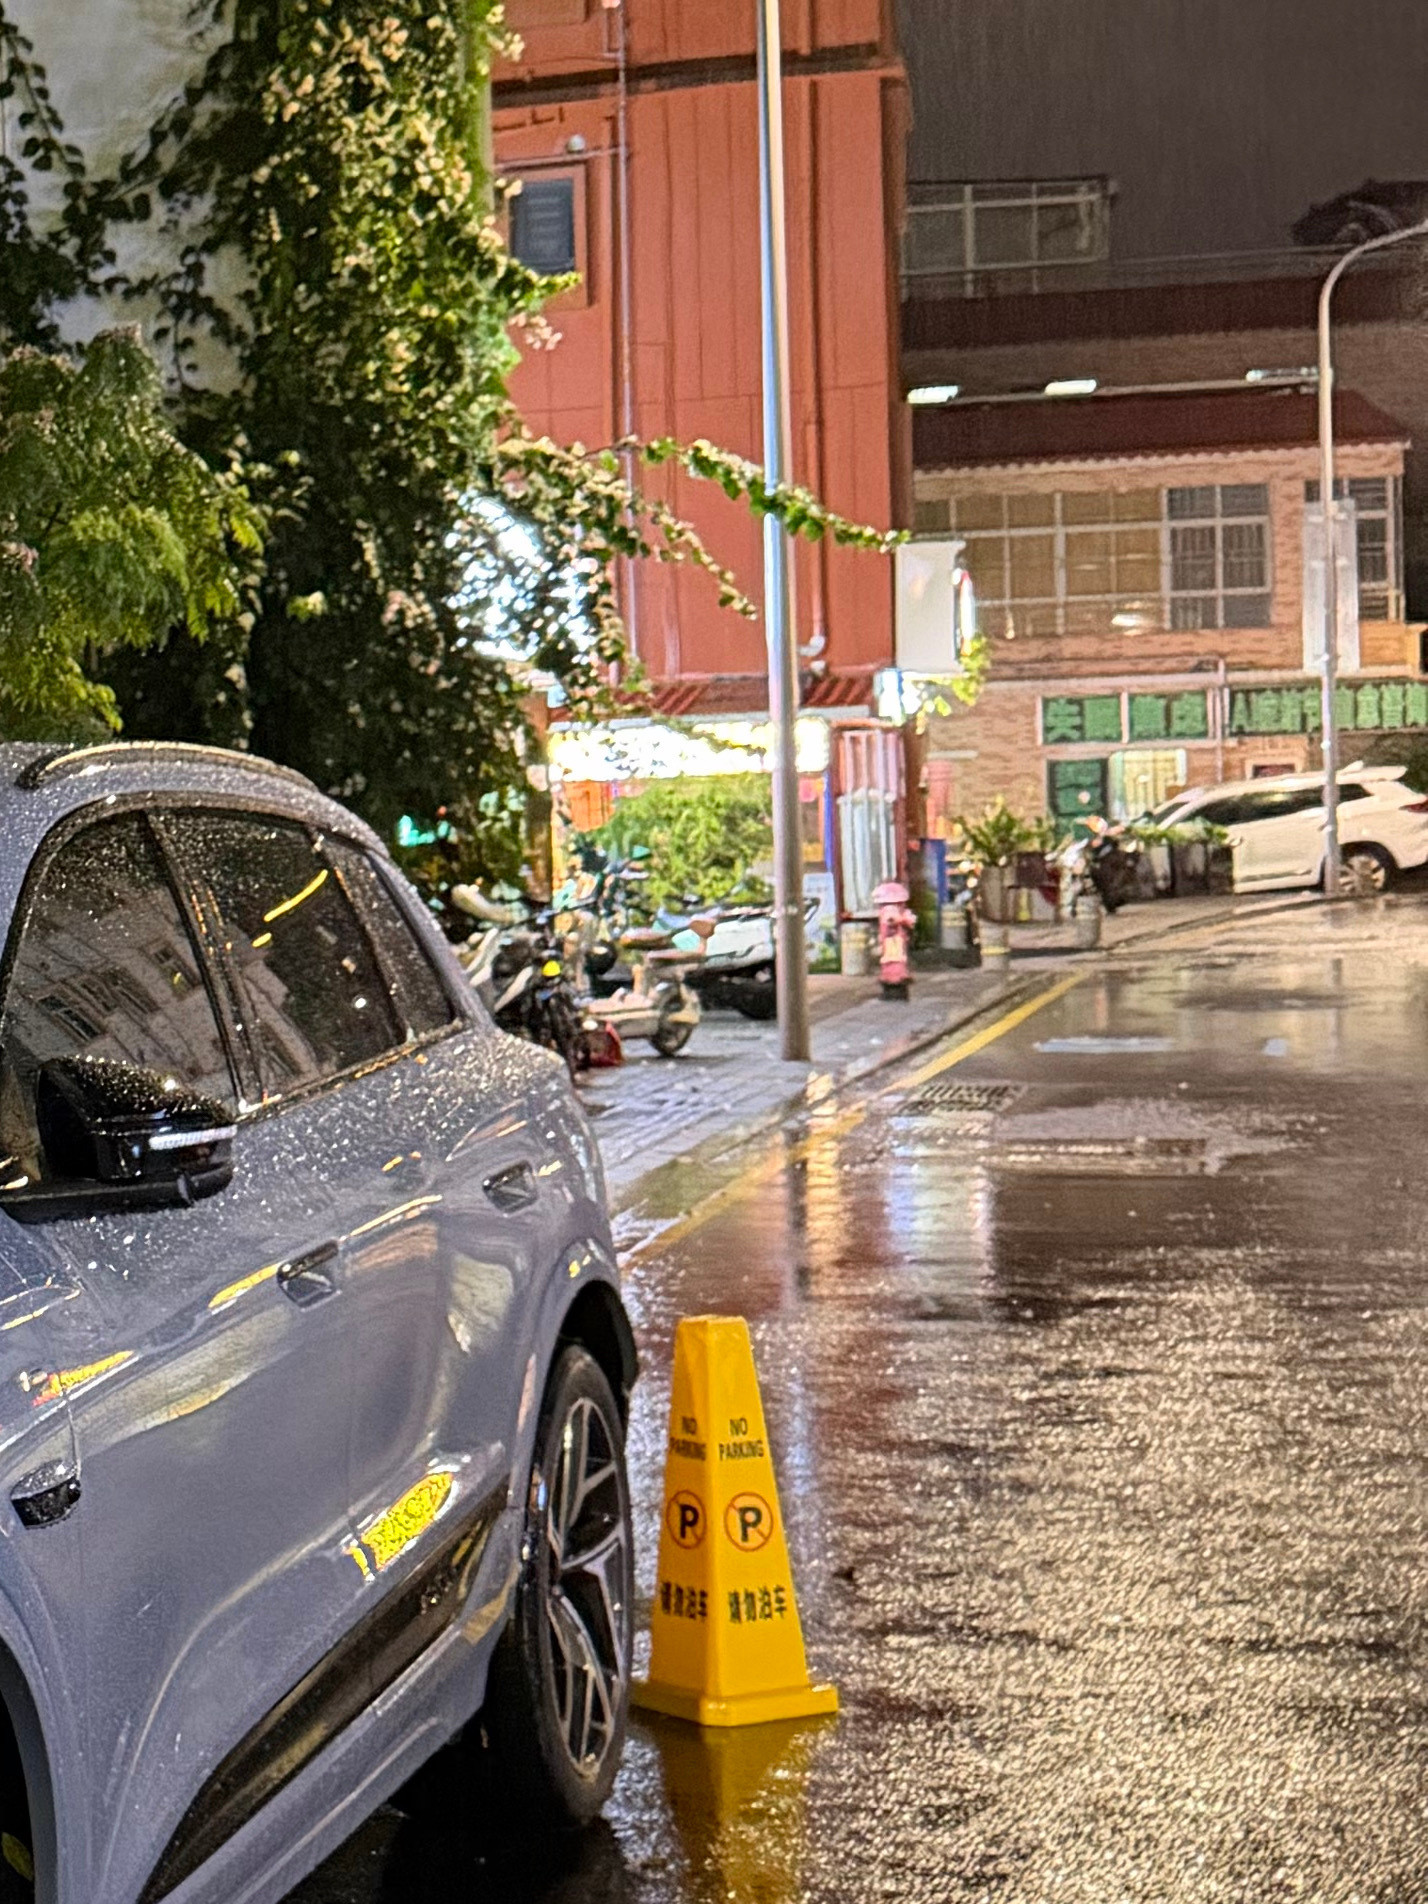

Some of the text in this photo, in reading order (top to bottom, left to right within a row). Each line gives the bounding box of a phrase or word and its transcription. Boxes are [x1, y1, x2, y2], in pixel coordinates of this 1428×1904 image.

[681, 1415, 698, 1436] NO
[729, 1417, 748, 1437] NO
[719, 1439, 765, 1462] PARKING
